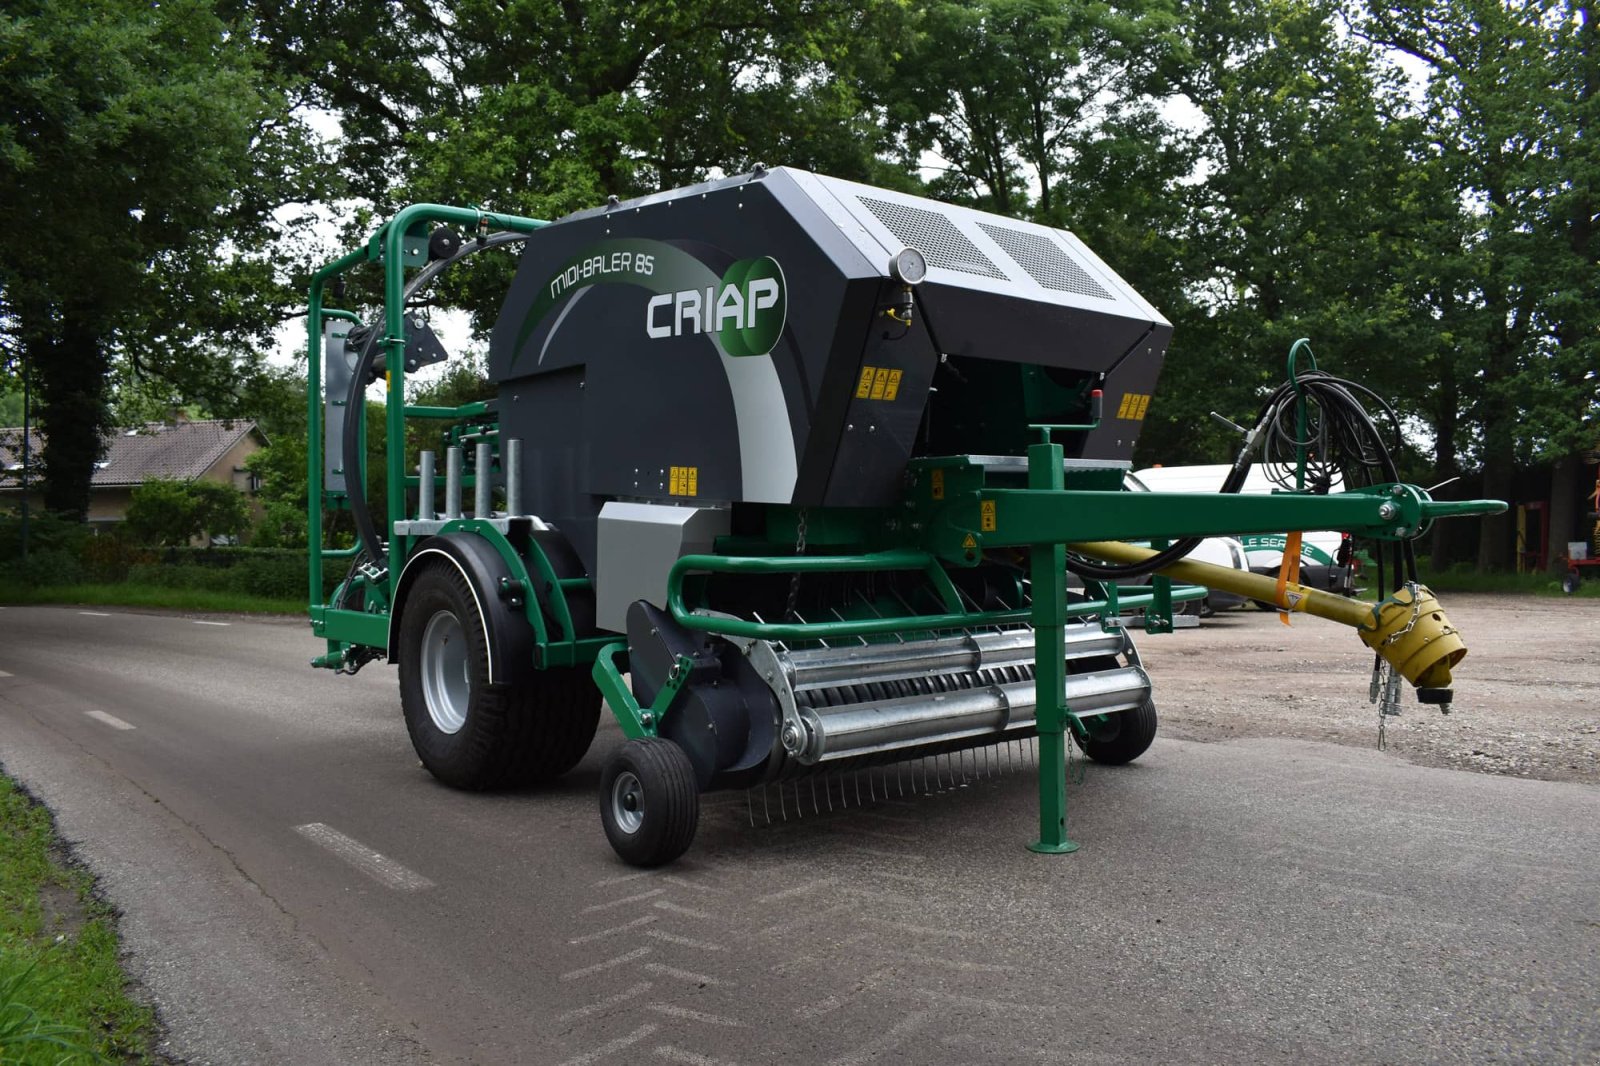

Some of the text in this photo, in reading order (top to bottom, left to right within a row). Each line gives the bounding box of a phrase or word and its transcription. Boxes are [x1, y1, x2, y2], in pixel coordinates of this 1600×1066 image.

[550, 252, 655, 299] MIDI-BALER 85
[646, 277, 779, 339] CRIAP
[1260, 538, 1314, 556] SERE
